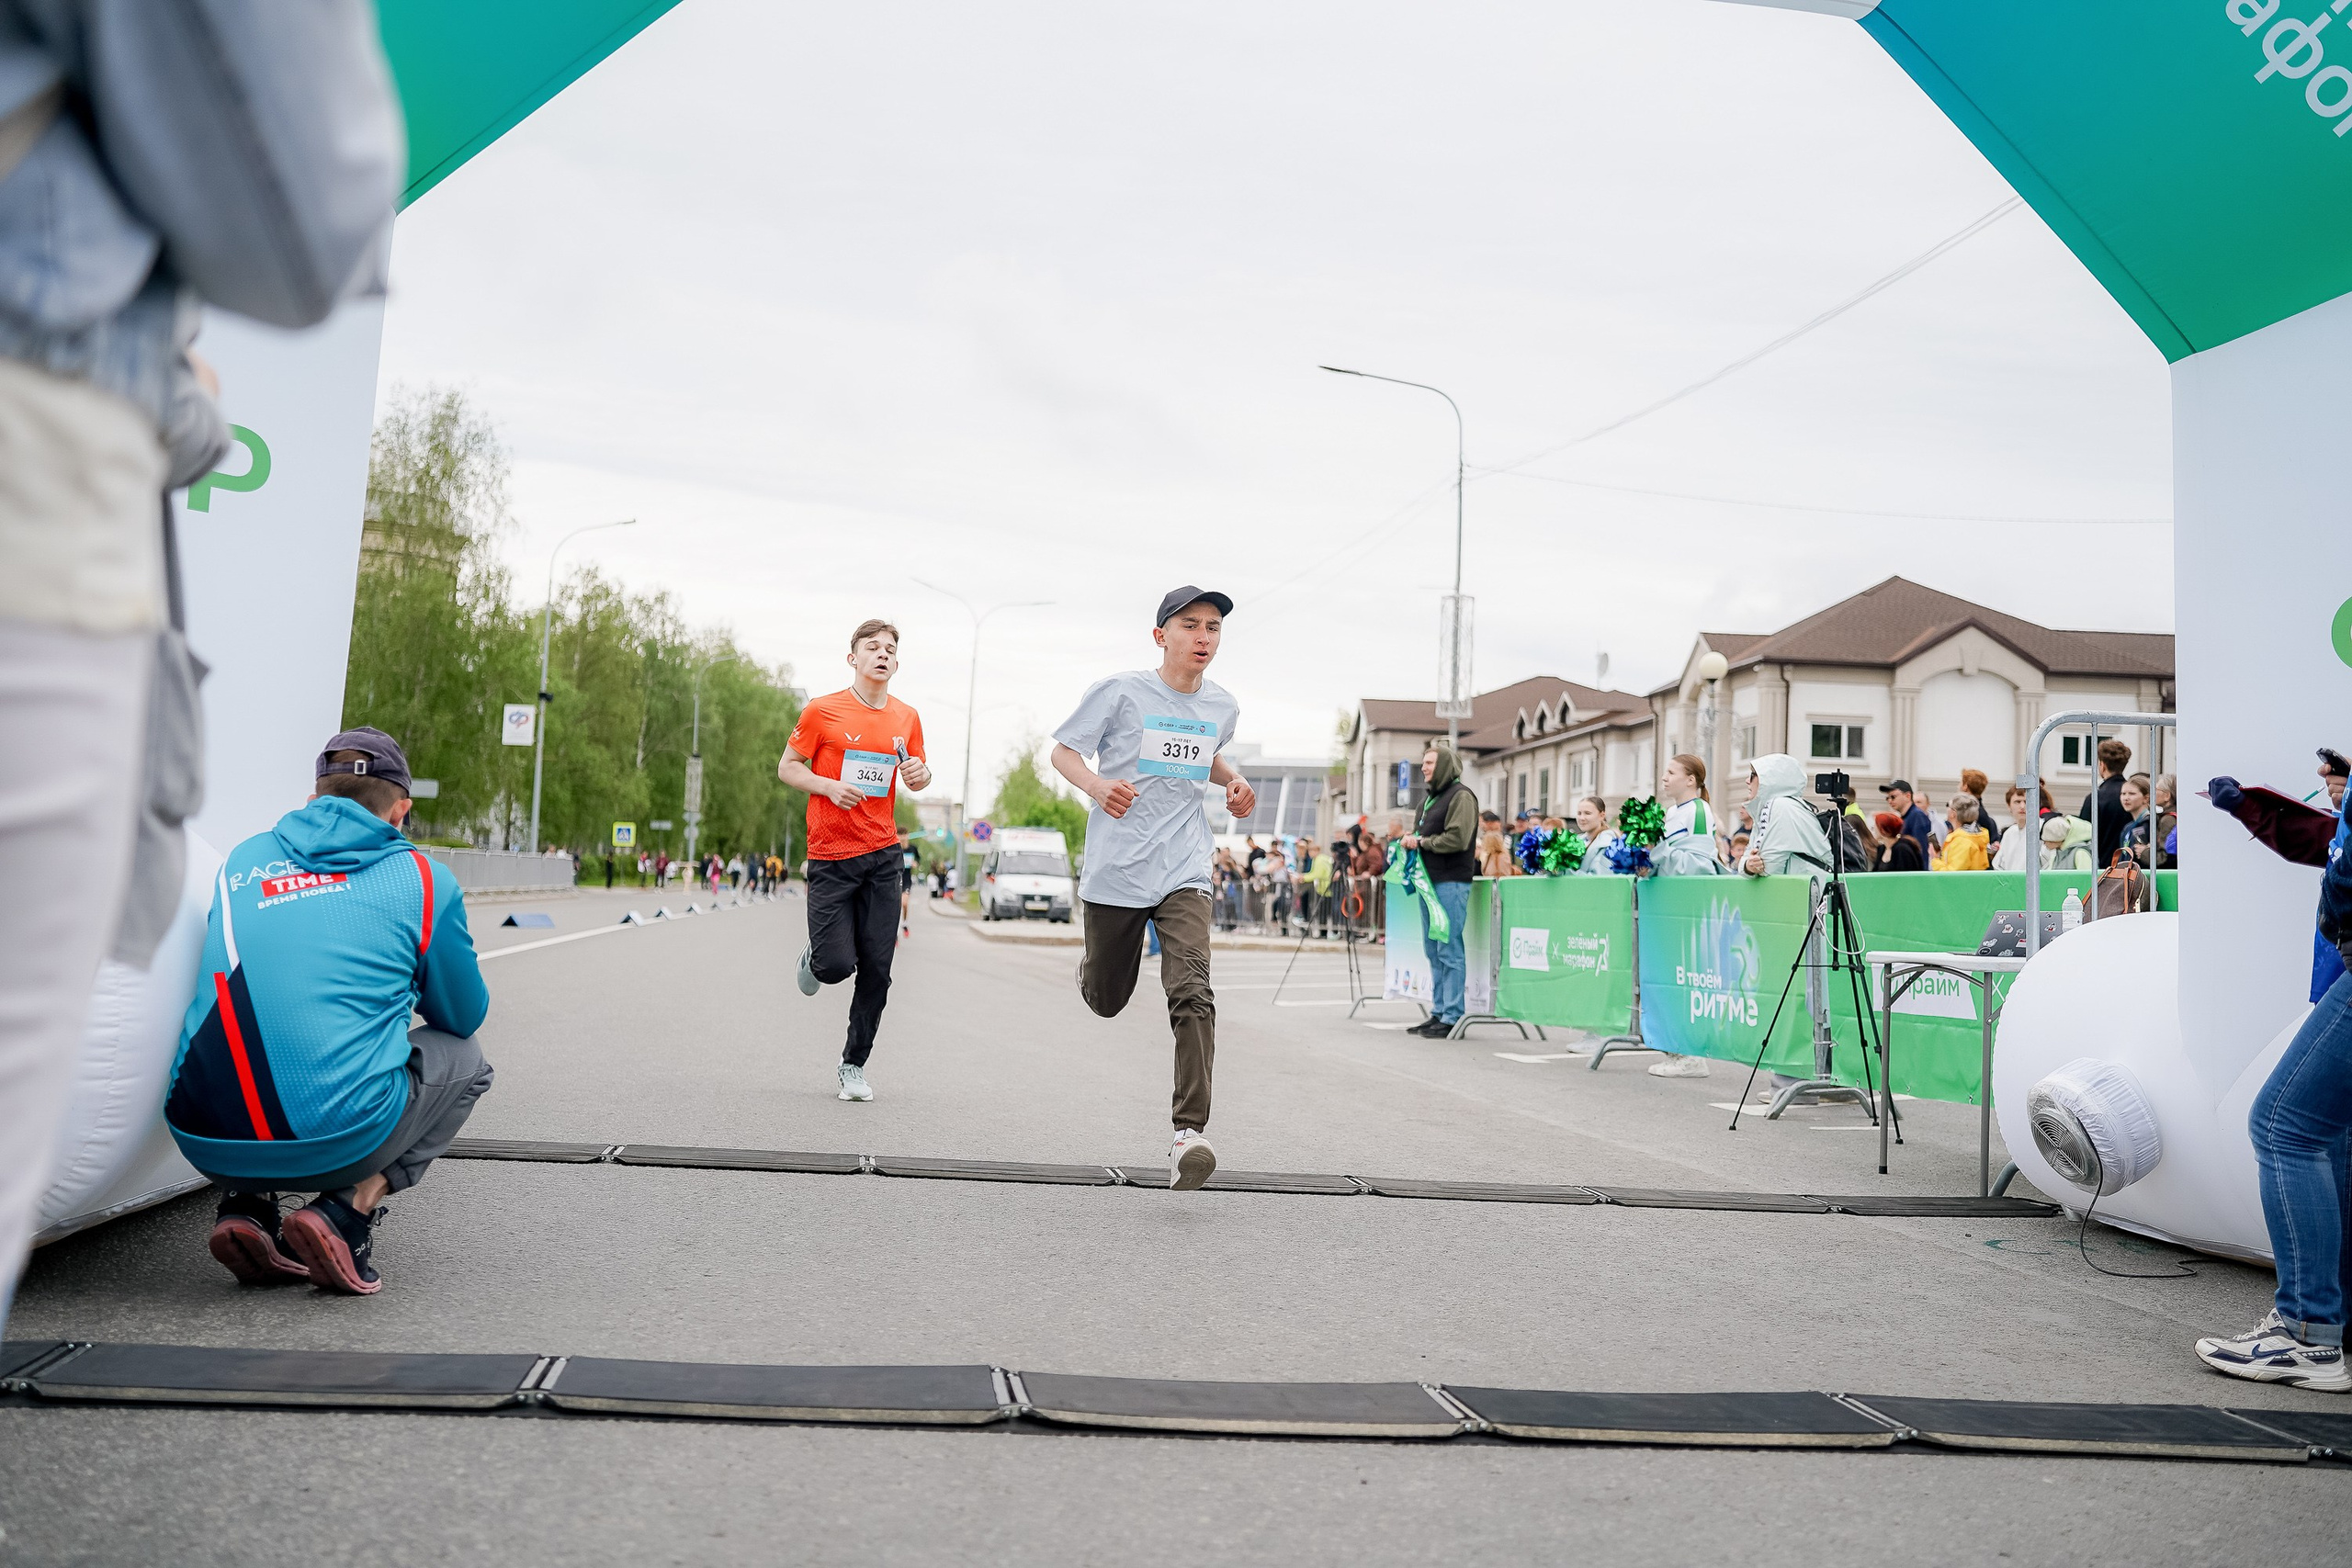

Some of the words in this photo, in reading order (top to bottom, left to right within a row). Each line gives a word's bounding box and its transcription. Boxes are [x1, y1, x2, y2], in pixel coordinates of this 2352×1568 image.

[2225, 0, 2352, 138] афо
[1162, 742, 1200, 761] 3319
[857, 769, 884, 783] 3434
[230, 860, 304, 892] RACE
[271, 874, 334, 893] TIME
[257, 893, 299, 910] ВРЕМЯ
[1566, 931, 1599, 951] зелёный
[1562, 951, 1596, 972] марафон
[1676, 965, 1686, 986] В
[1687, 968, 1723, 990] твоём
[1690, 990, 1758, 1028] ритме
